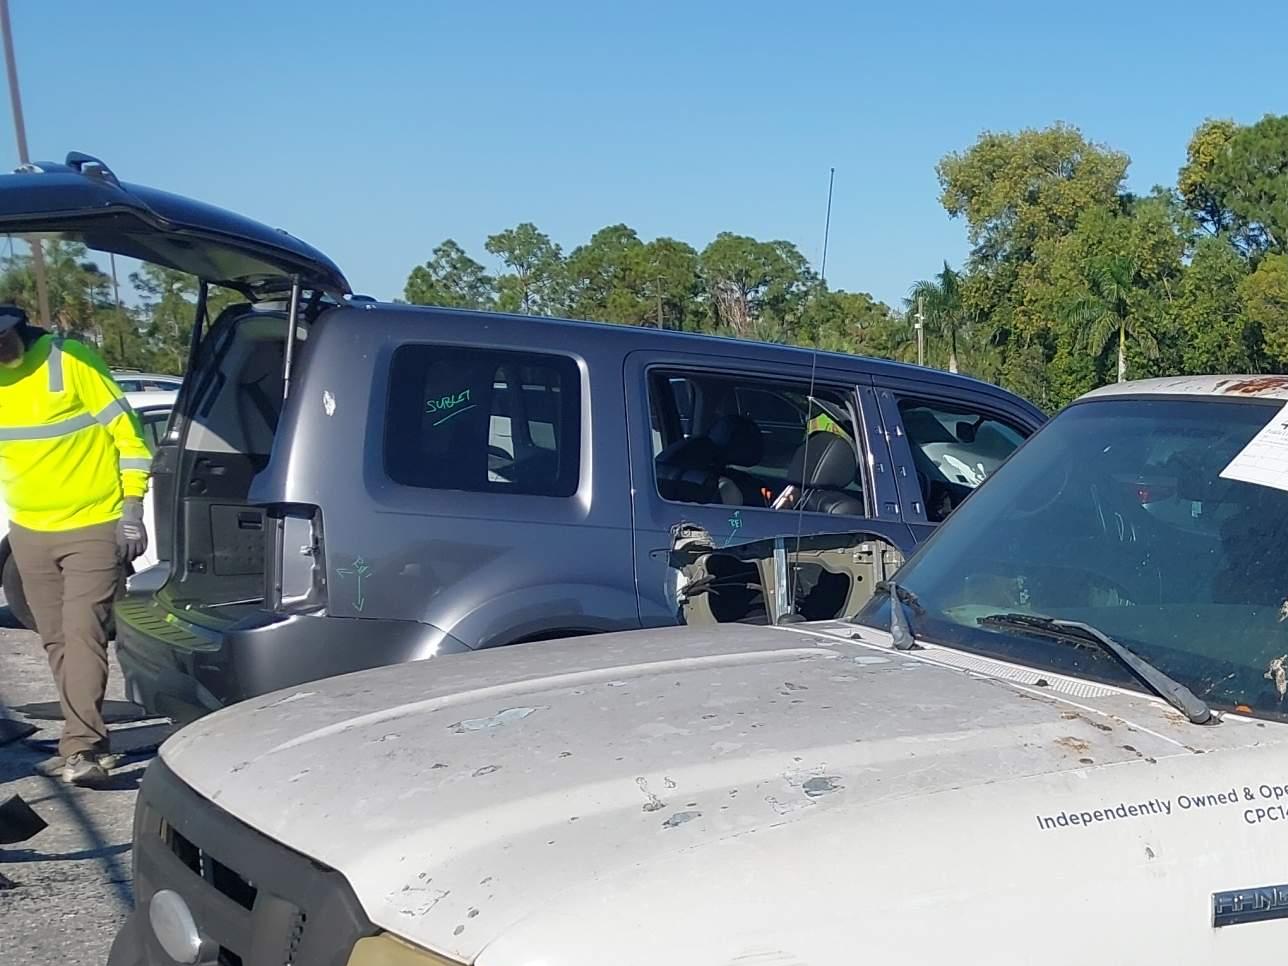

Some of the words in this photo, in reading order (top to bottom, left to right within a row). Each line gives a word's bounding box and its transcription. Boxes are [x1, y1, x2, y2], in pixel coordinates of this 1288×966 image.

[1036, 798, 1172, 830] Independently
[1177, 789, 1238, 811] Owned
[1243, 786, 1255, 801] &
